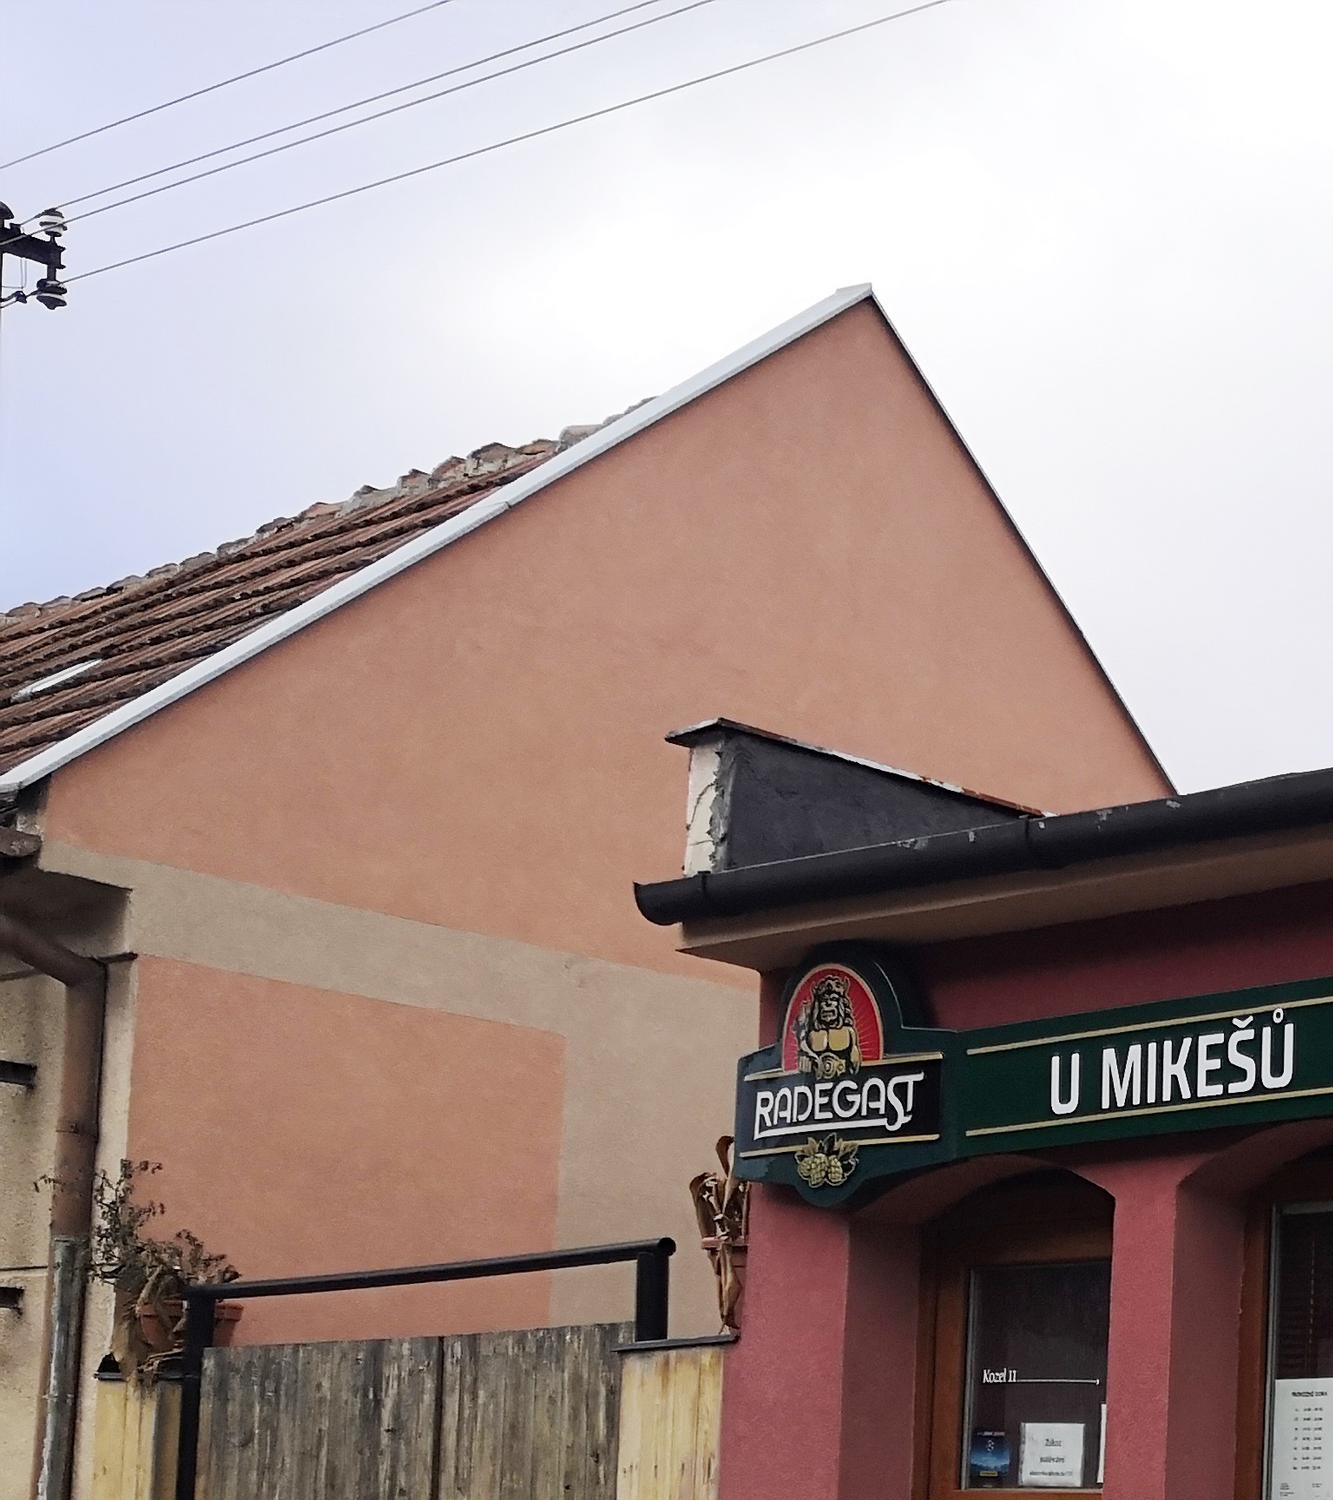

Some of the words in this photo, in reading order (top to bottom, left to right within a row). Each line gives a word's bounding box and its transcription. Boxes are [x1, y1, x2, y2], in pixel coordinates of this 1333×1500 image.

[1050, 1052, 1080, 1115] U
[1101, 1007, 1294, 1110] MIKEŠŮ
[753, 1071, 925, 1141] RADEGAST
